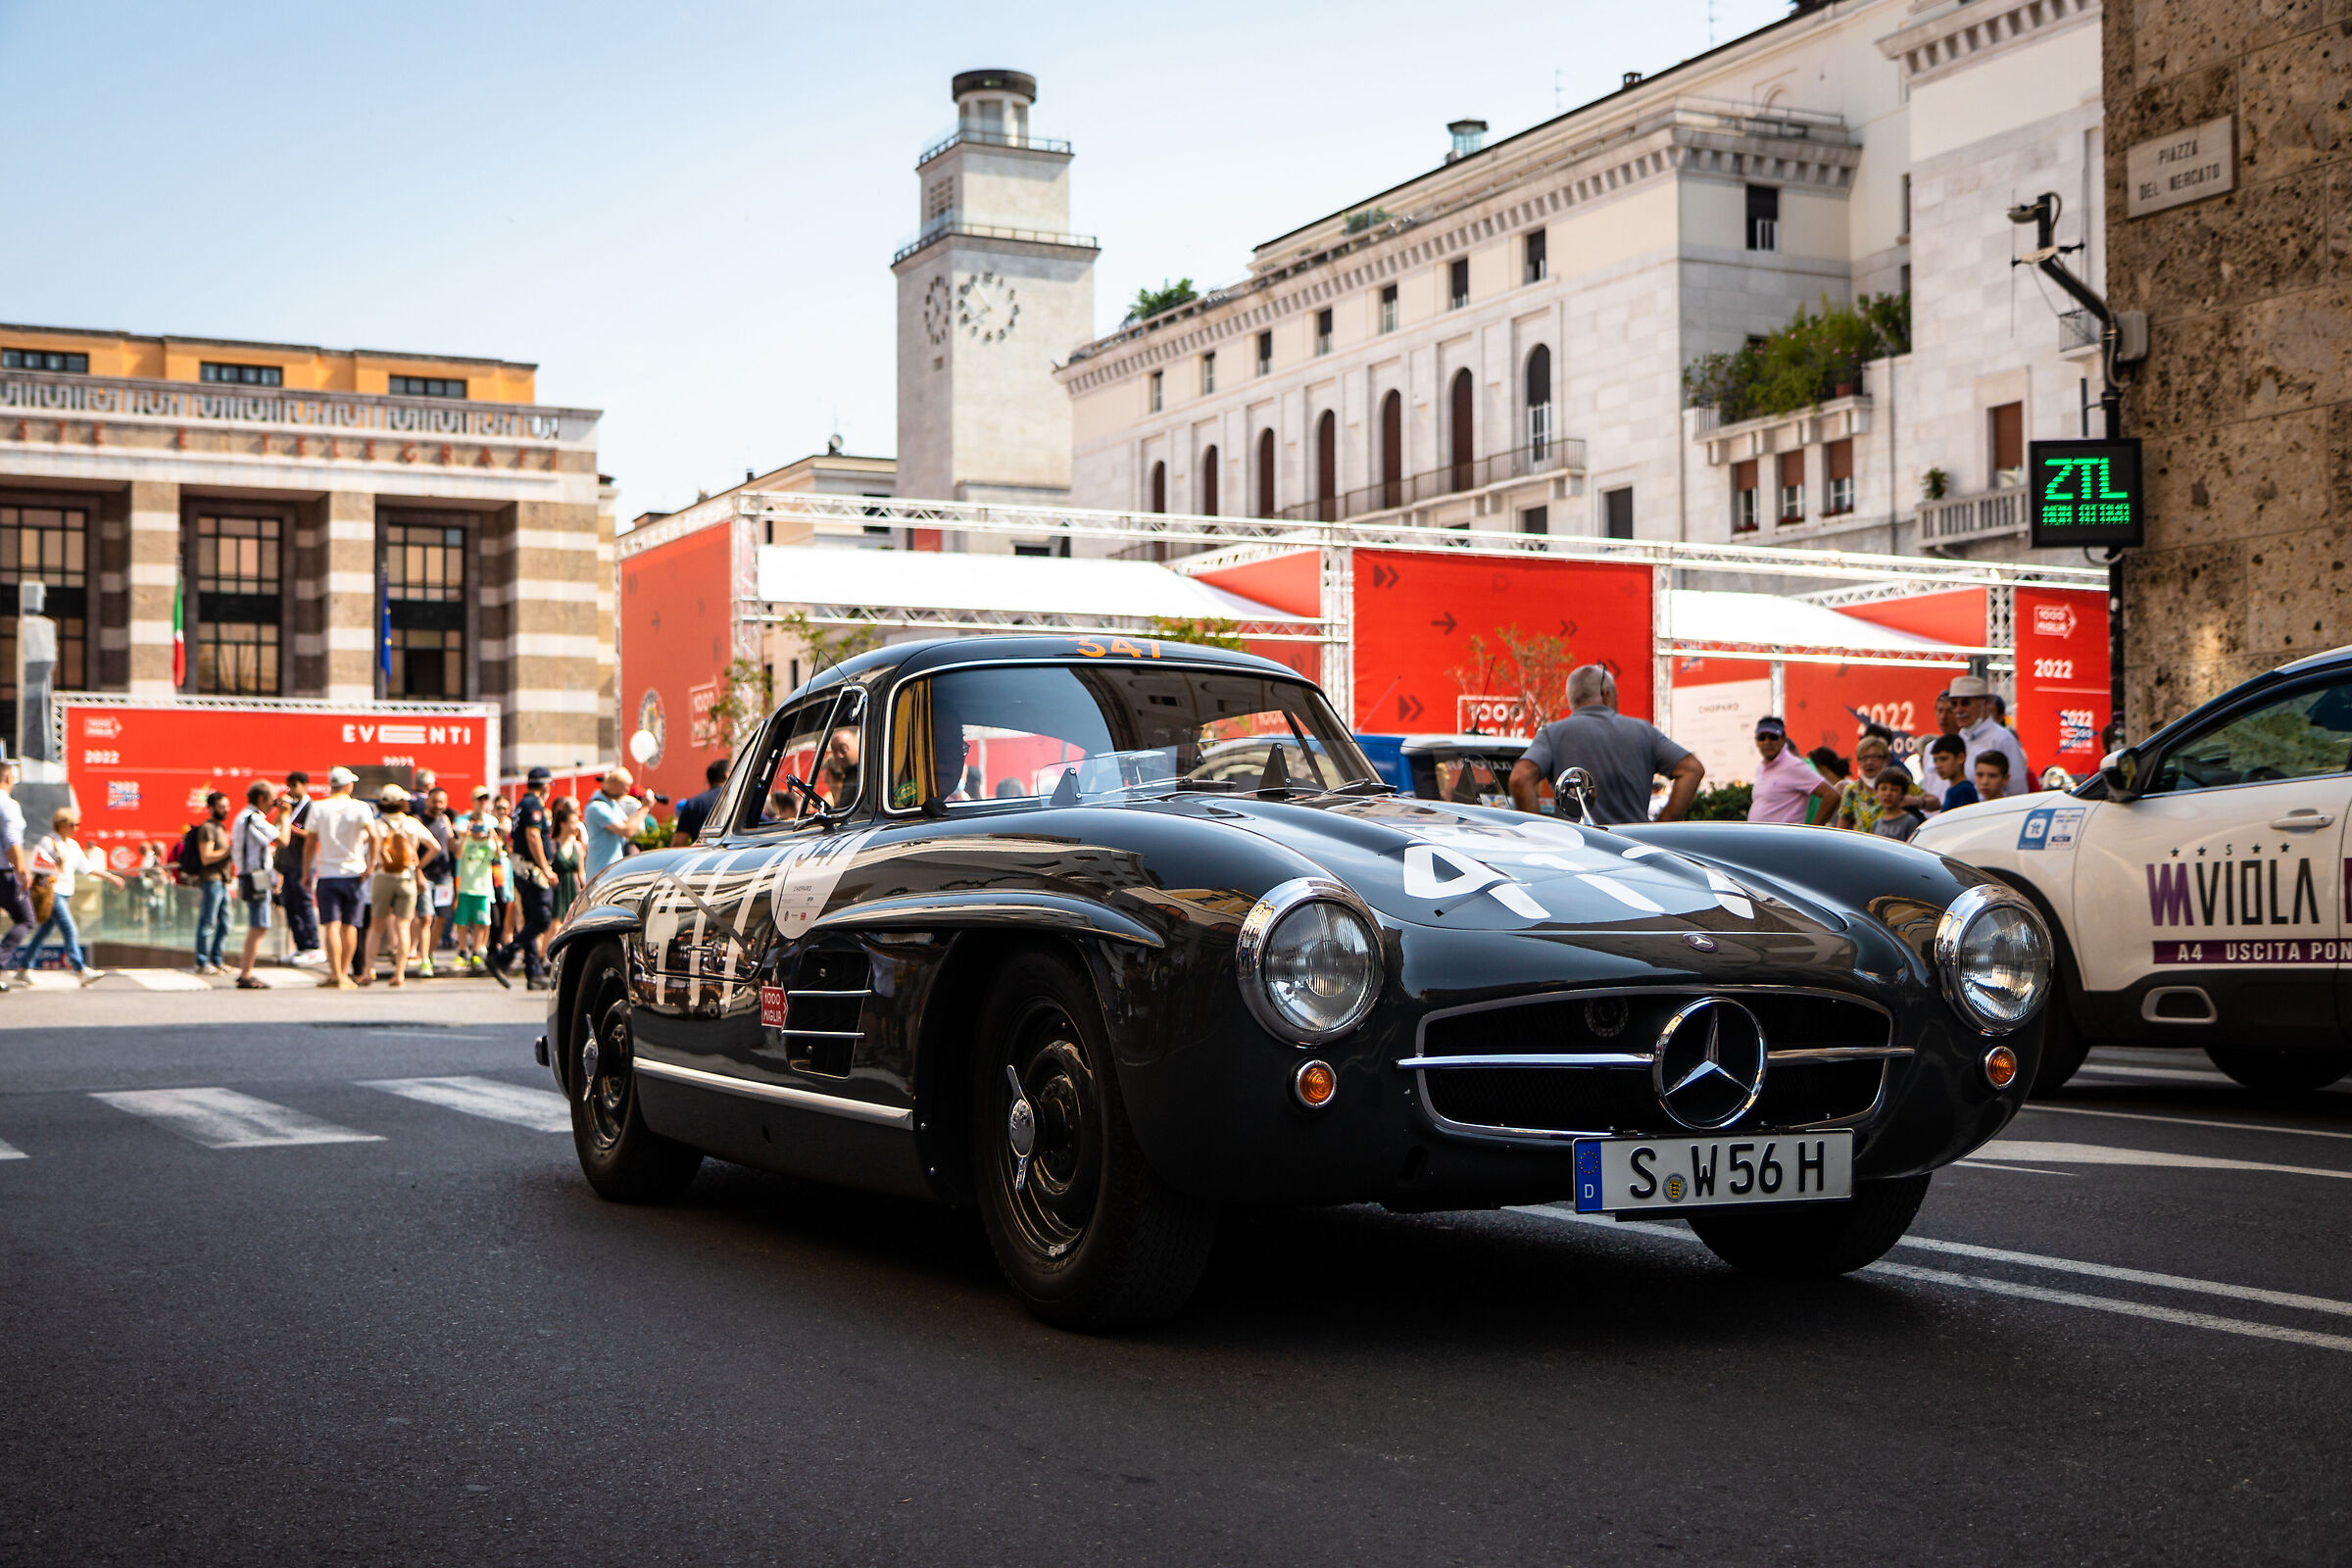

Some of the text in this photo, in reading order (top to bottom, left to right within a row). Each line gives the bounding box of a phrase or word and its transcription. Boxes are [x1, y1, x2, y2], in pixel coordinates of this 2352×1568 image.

[2158, 139, 2198, 165] PIAZZA
[2139, 163, 2220, 201] DEL MERCATO
[261, 433, 559, 470] TELEGRAFI
[2044, 458, 2129, 501] ZTL
[2034, 659, 2074, 679] 2022
[2060, 710, 2094, 728] 2022
[343, 723, 471, 745] EVENTI
[84, 750, 121, 764] 2022
[2178, 943, 2203, 961] A4
[2226, 942, 2301, 961] USCITA
[764, 992, 781, 1005] 1000
[764, 1009, 782, 1022] MIGLIA
[1584, 1184, 1594, 1199] D
[1629, 1147, 1658, 1199] S
